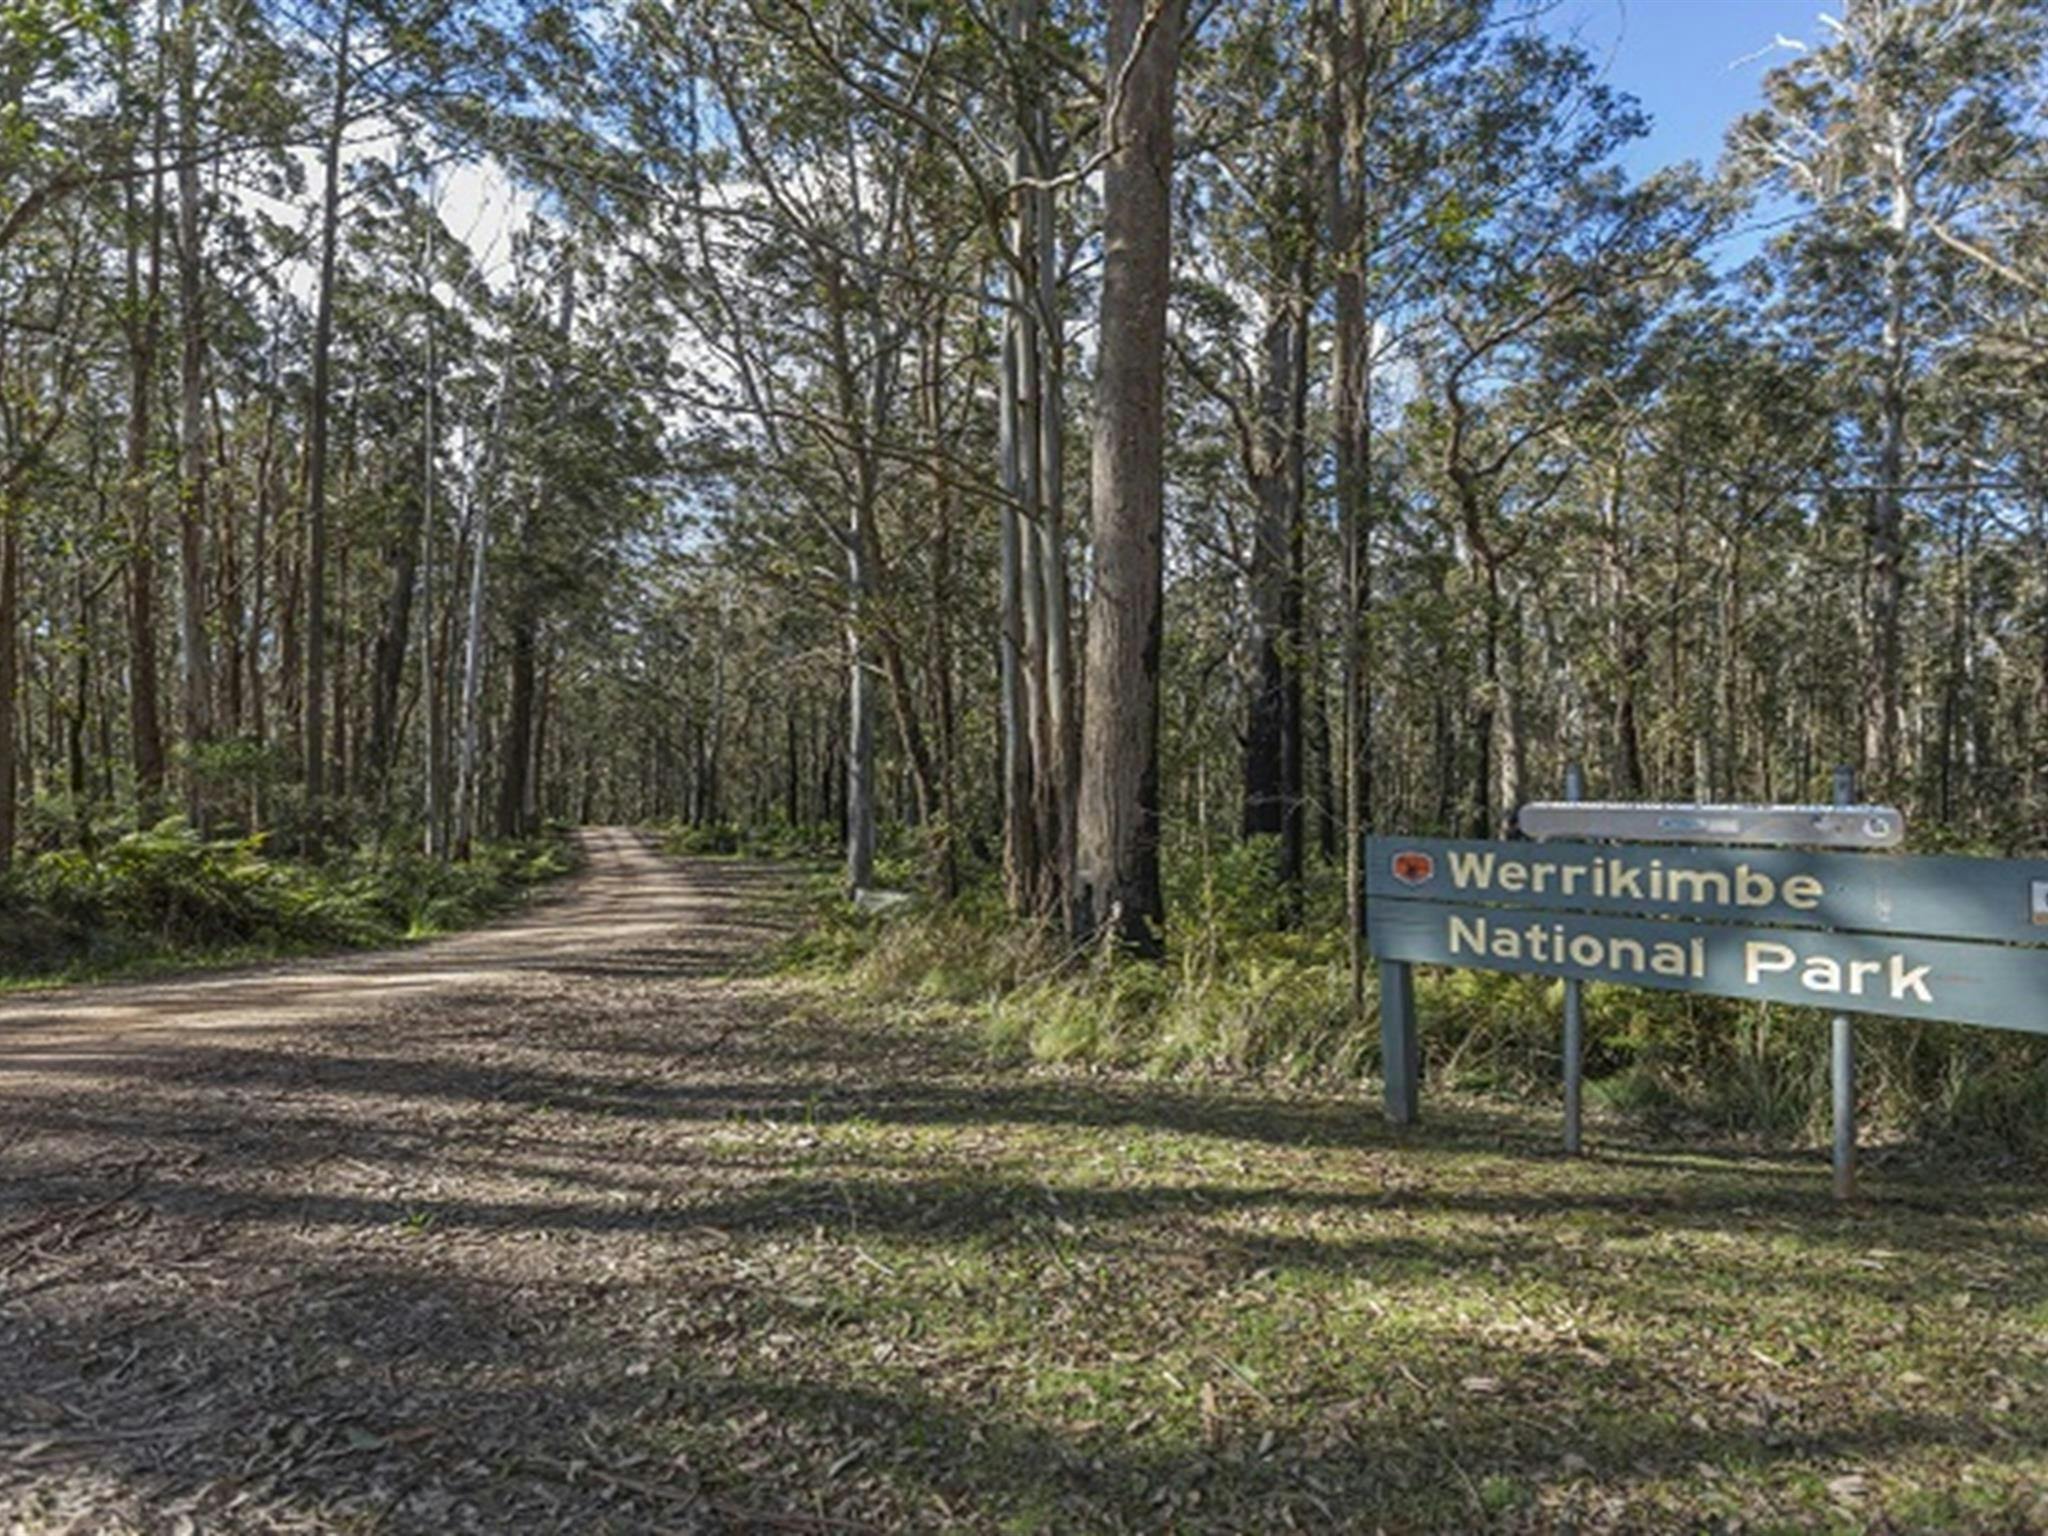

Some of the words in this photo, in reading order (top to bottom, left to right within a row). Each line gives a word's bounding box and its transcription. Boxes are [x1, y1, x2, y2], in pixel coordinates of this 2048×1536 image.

[1447, 850, 1824, 910] Werrikimbe
[1448, 916, 1705, 979] National
[1745, 941, 1934, 1002] Park
